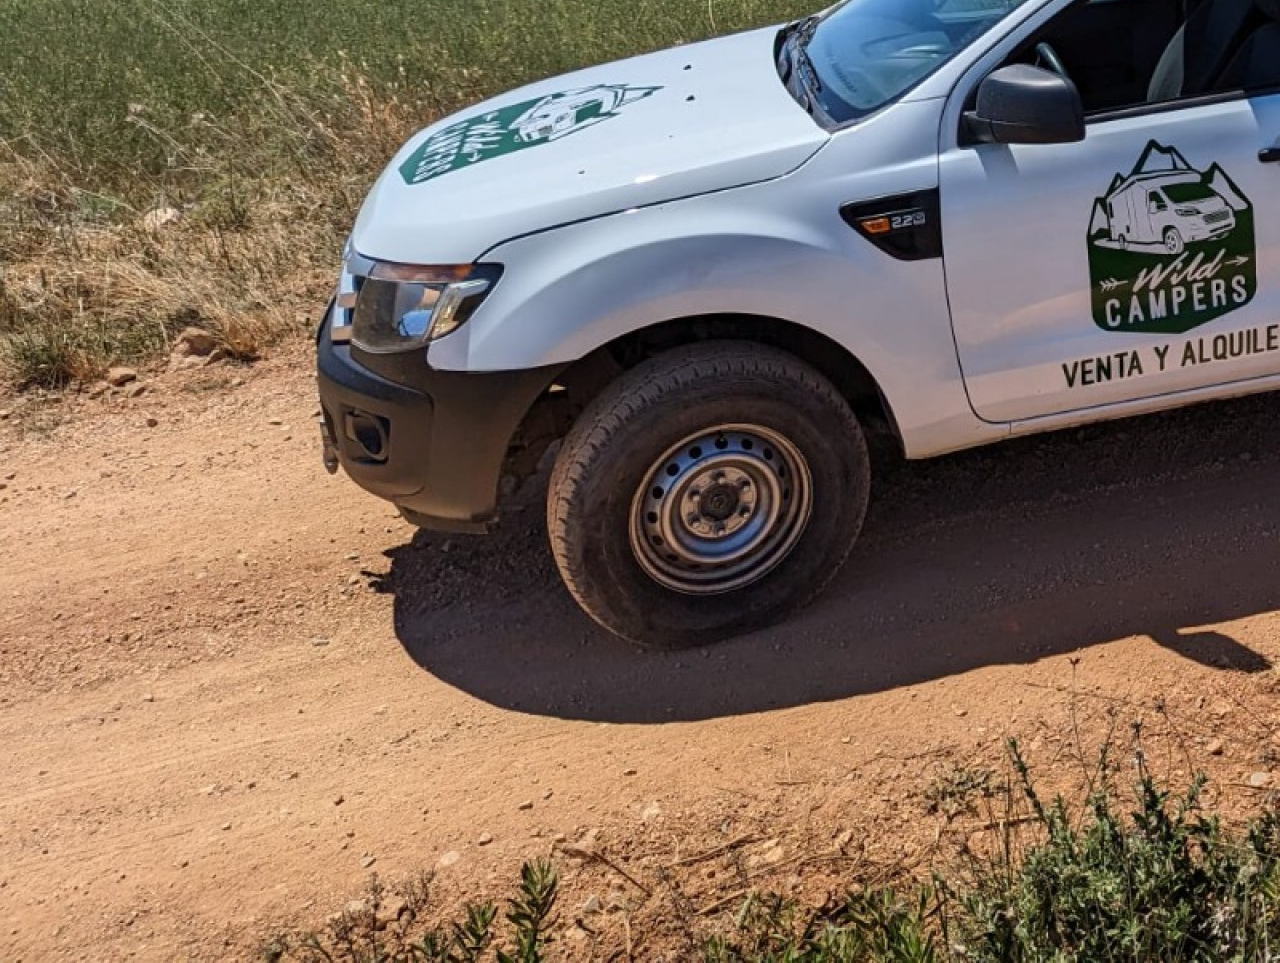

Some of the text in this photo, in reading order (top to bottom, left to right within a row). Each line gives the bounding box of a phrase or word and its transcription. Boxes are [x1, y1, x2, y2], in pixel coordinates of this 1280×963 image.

[1132, 248, 1227, 293] Wild
[1105, 274, 1248, 328] CAMPERS
[1062, 349, 1144, 388] VENTA
[1153, 344, 1170, 372] Y
